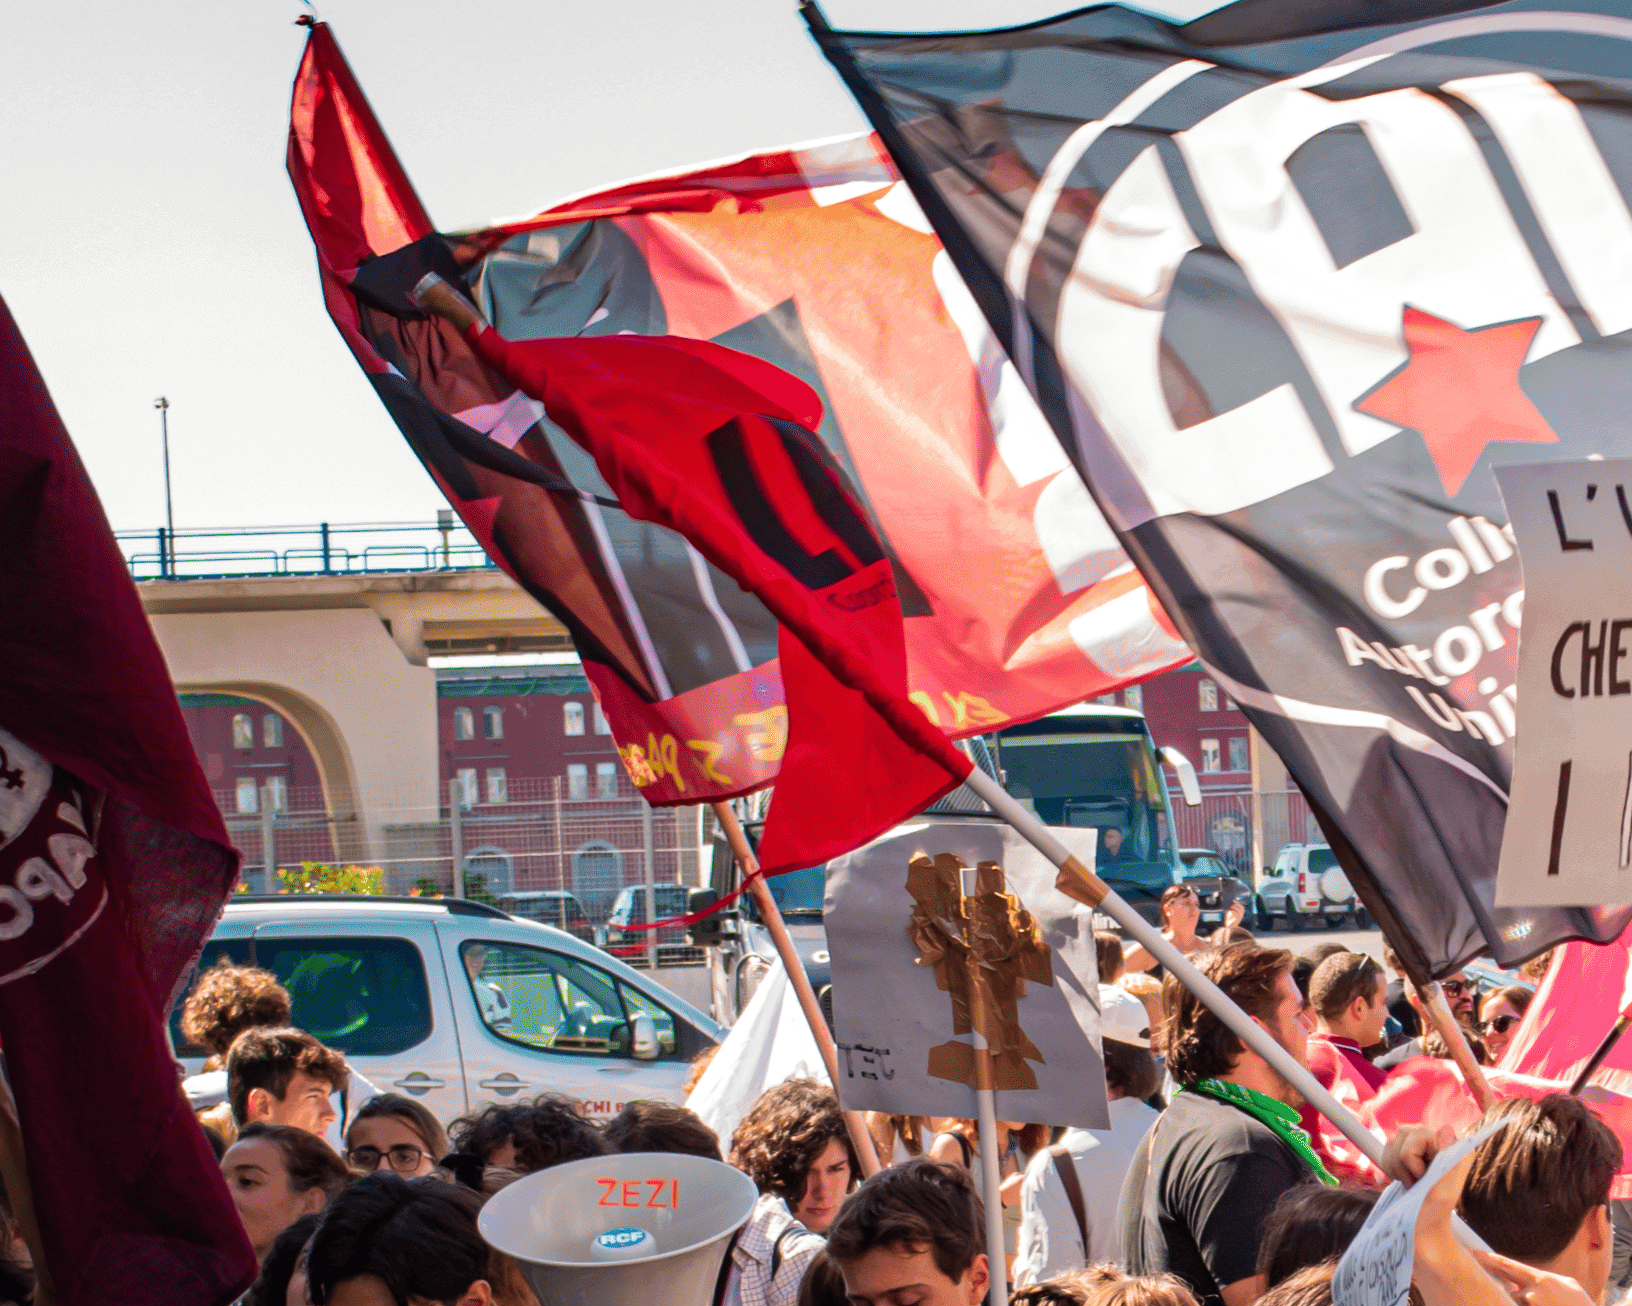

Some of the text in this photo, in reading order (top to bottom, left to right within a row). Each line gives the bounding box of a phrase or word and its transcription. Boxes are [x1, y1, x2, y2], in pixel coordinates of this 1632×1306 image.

[1548, 760, 1573, 877] I
[595, 1177, 679, 1209] ZEZI
[600, 1231, 643, 1245] RCF
